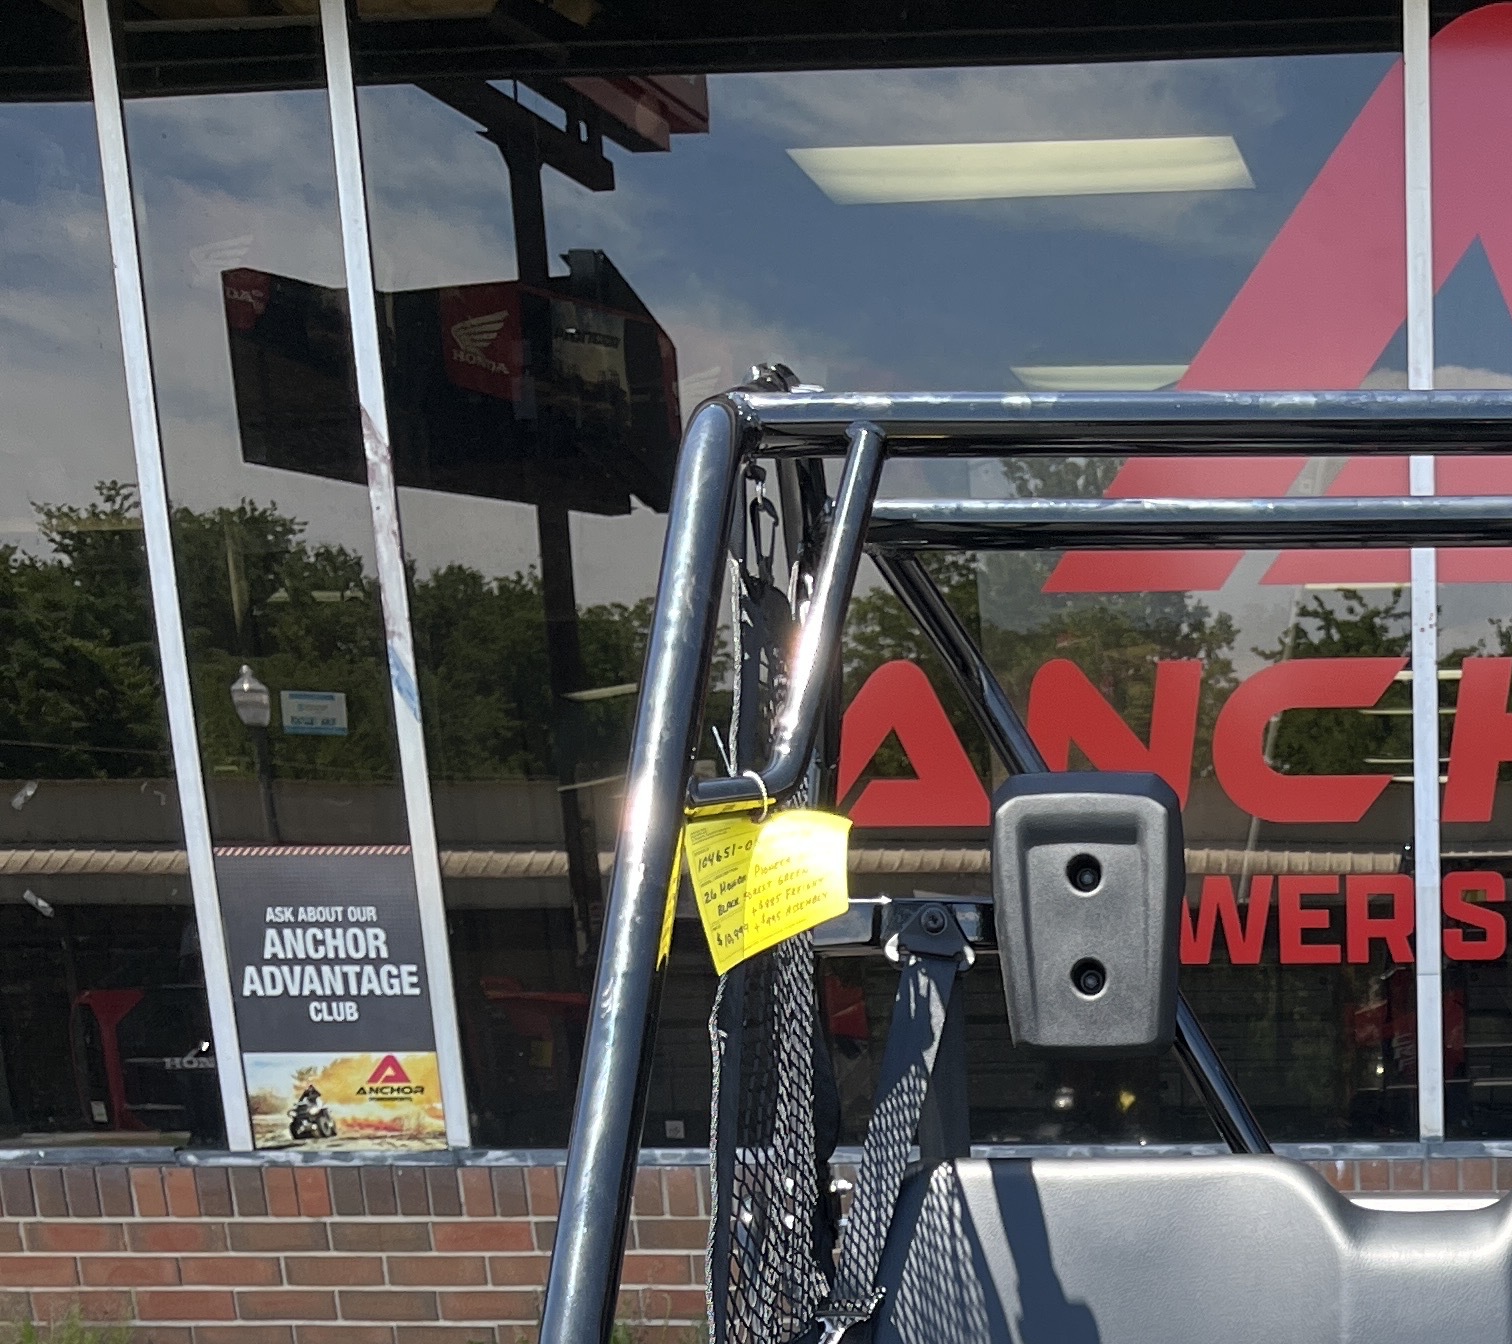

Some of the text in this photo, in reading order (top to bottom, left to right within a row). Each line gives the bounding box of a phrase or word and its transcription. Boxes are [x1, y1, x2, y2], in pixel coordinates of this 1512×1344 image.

[265, 905, 378, 922] ASK ABOUT OUR
[263, 927, 389, 960] ANCHOR
[242, 964, 421, 997] ADVANTAGE
[308, 1001, 360, 1022] CLUB
[163, 1057, 216, 1070] HON
[356, 1085, 425, 1096] ANCHOR
